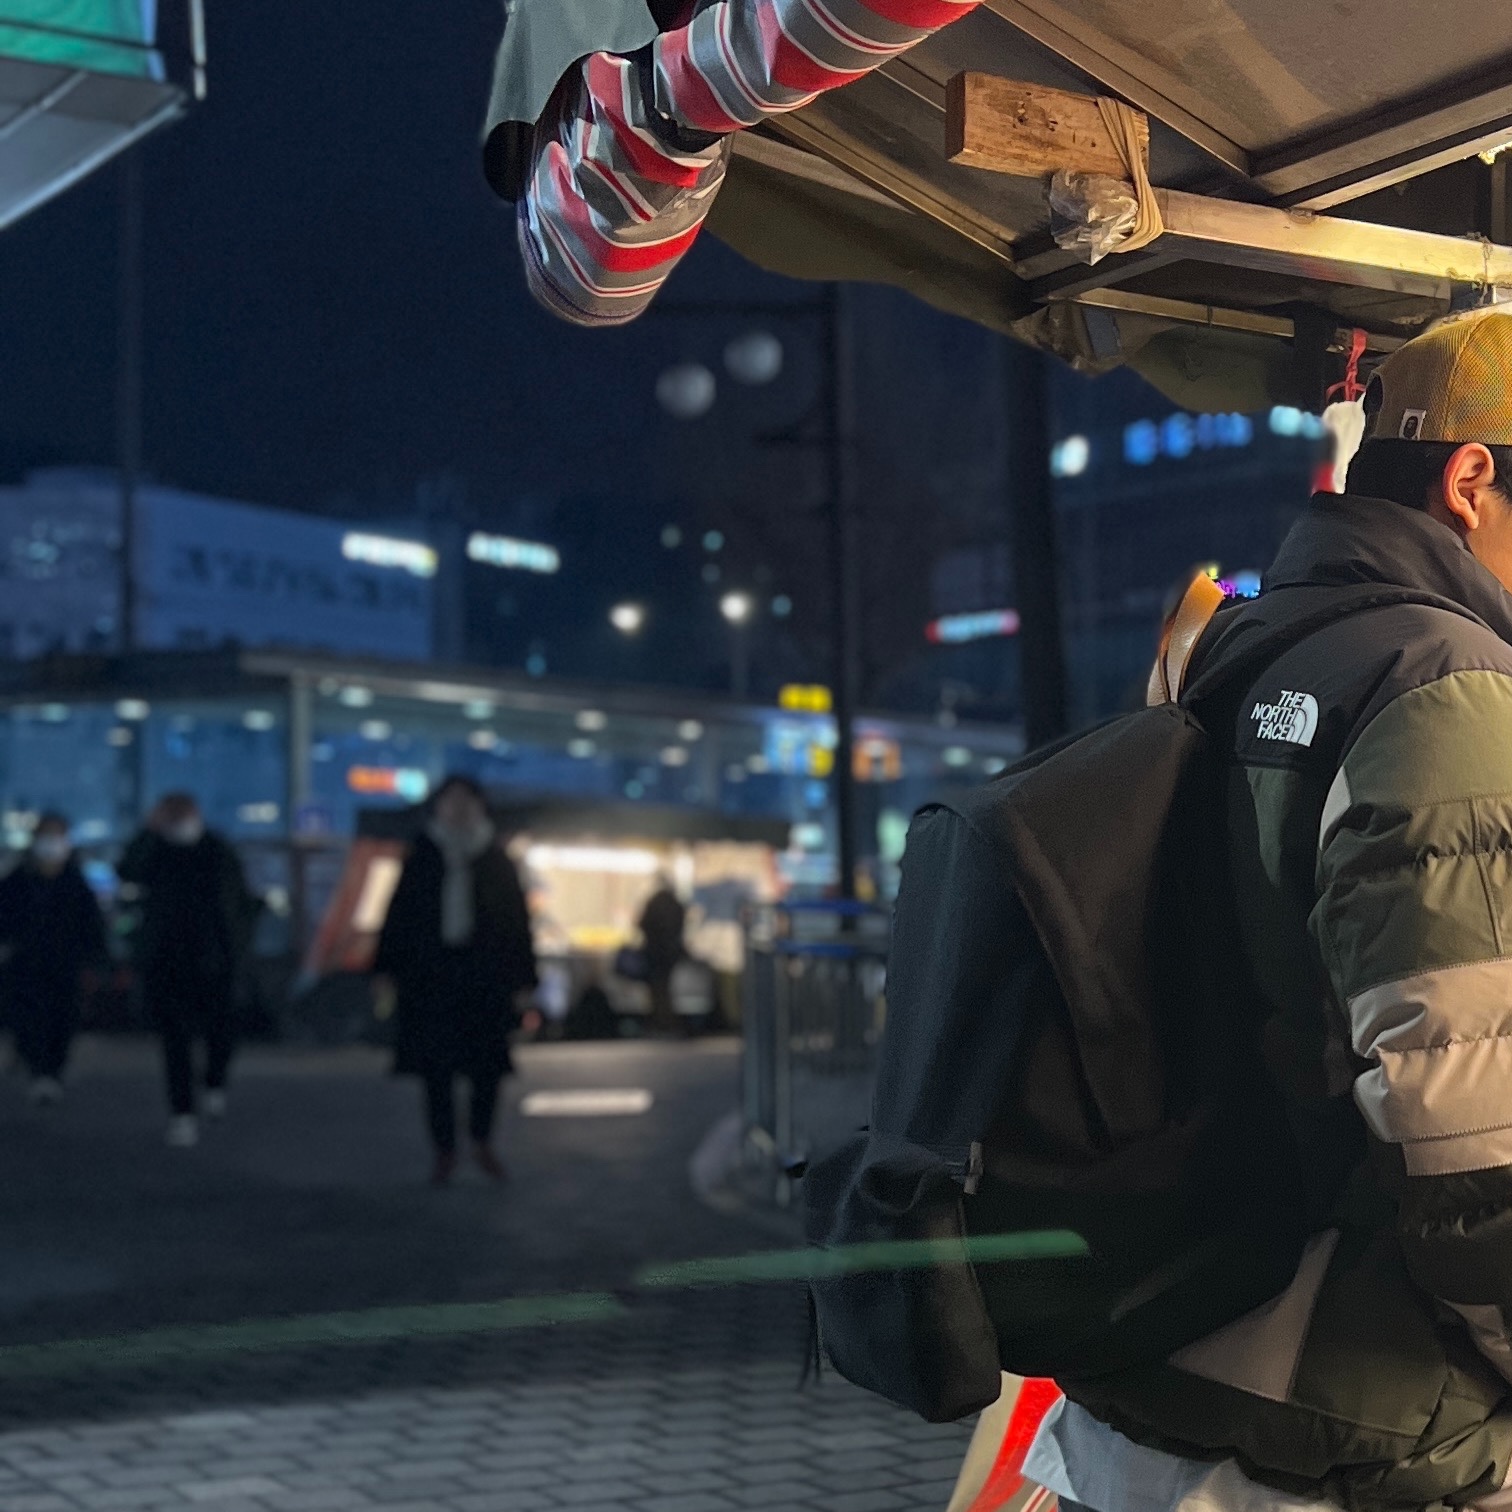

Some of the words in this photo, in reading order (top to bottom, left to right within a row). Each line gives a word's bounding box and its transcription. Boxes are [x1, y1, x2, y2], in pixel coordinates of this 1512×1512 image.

[1278, 689, 1306, 708] THE
[1250, 702, 1298, 726] NORTH
[1256, 720, 1291, 741] FACE
